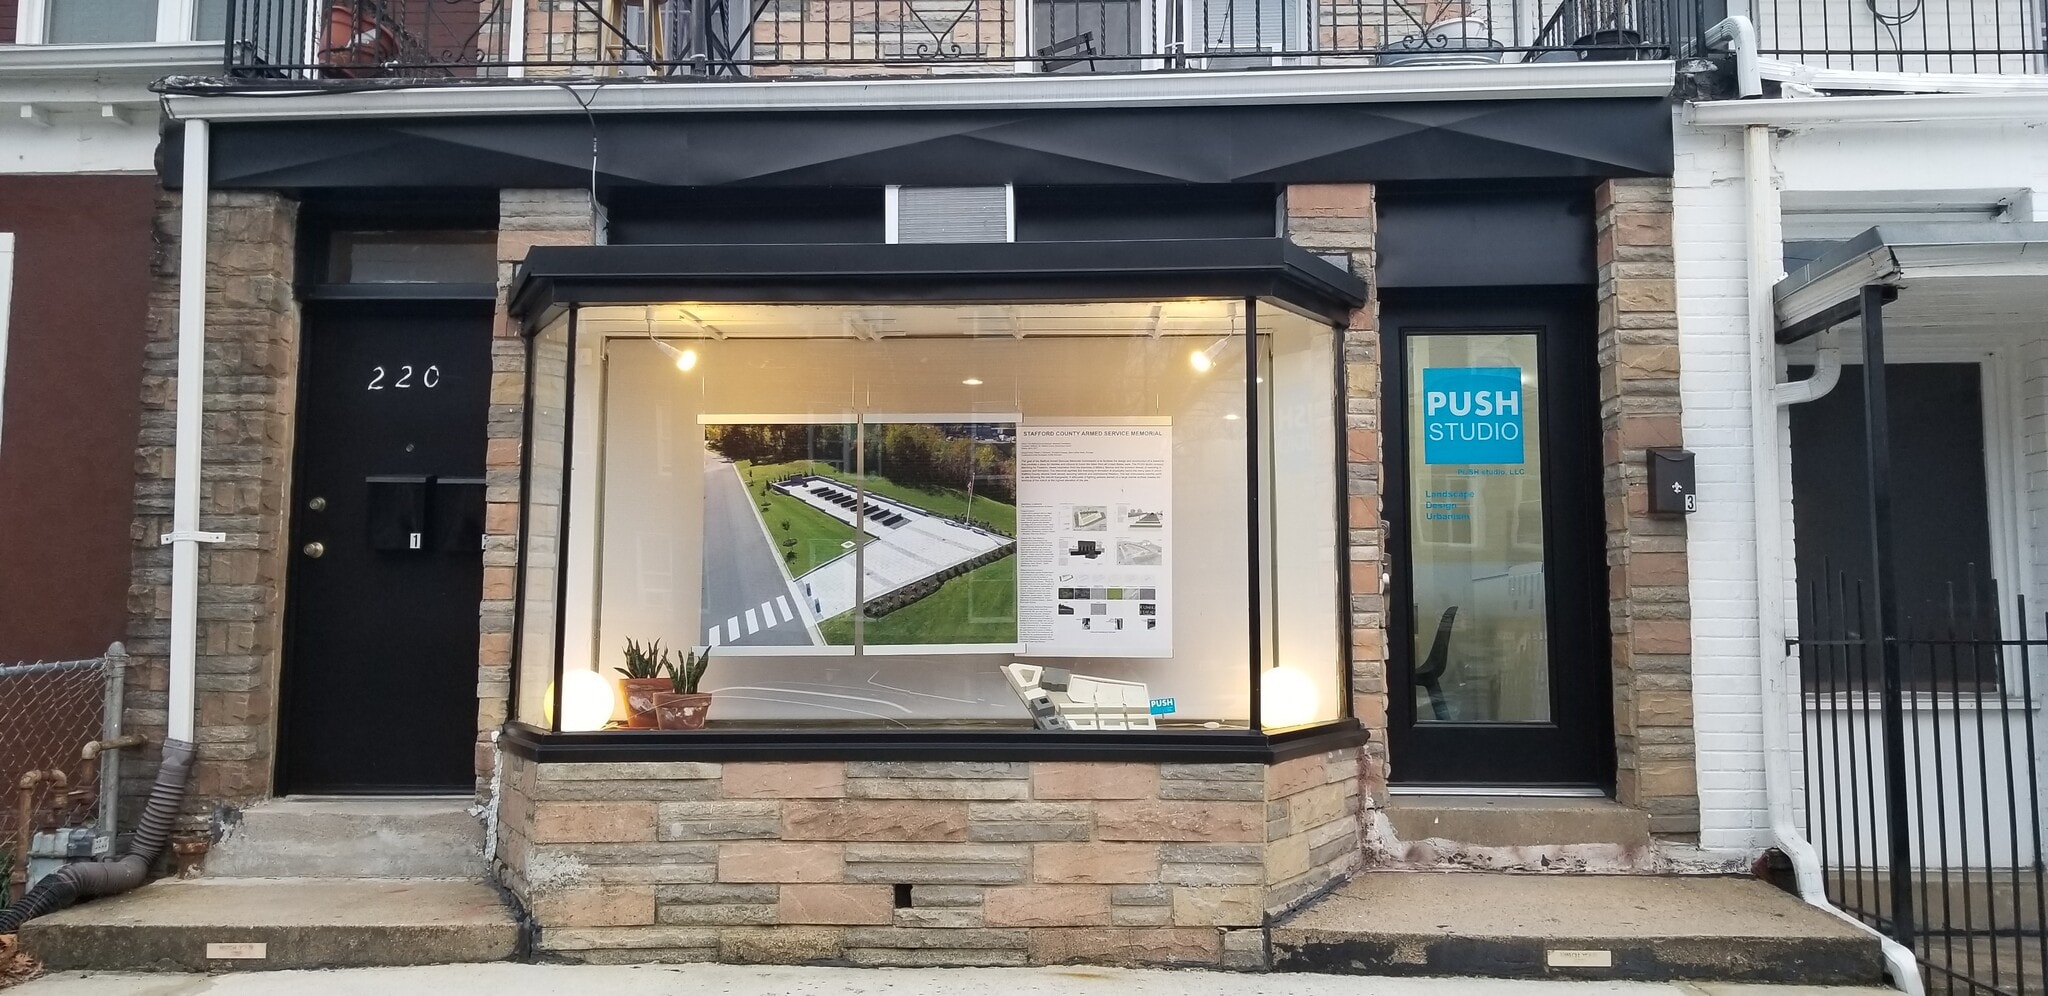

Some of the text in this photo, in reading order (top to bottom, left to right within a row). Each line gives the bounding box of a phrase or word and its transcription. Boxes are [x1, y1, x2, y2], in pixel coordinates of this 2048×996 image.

[367, 365, 440, 390] 220
[1427, 390, 1519, 417] PUSH
[1429, 422, 1519, 441] STUDIO
[1425, 490, 1475, 499] Landscape
[1425, 502, 1457, 511] Design
[1687, 495, 1694, 510] 3
[1426, 512, 1472, 520] Urbanism
[412, 534, 418, 548] 1
[1151, 698, 1173, 707] PUSH
